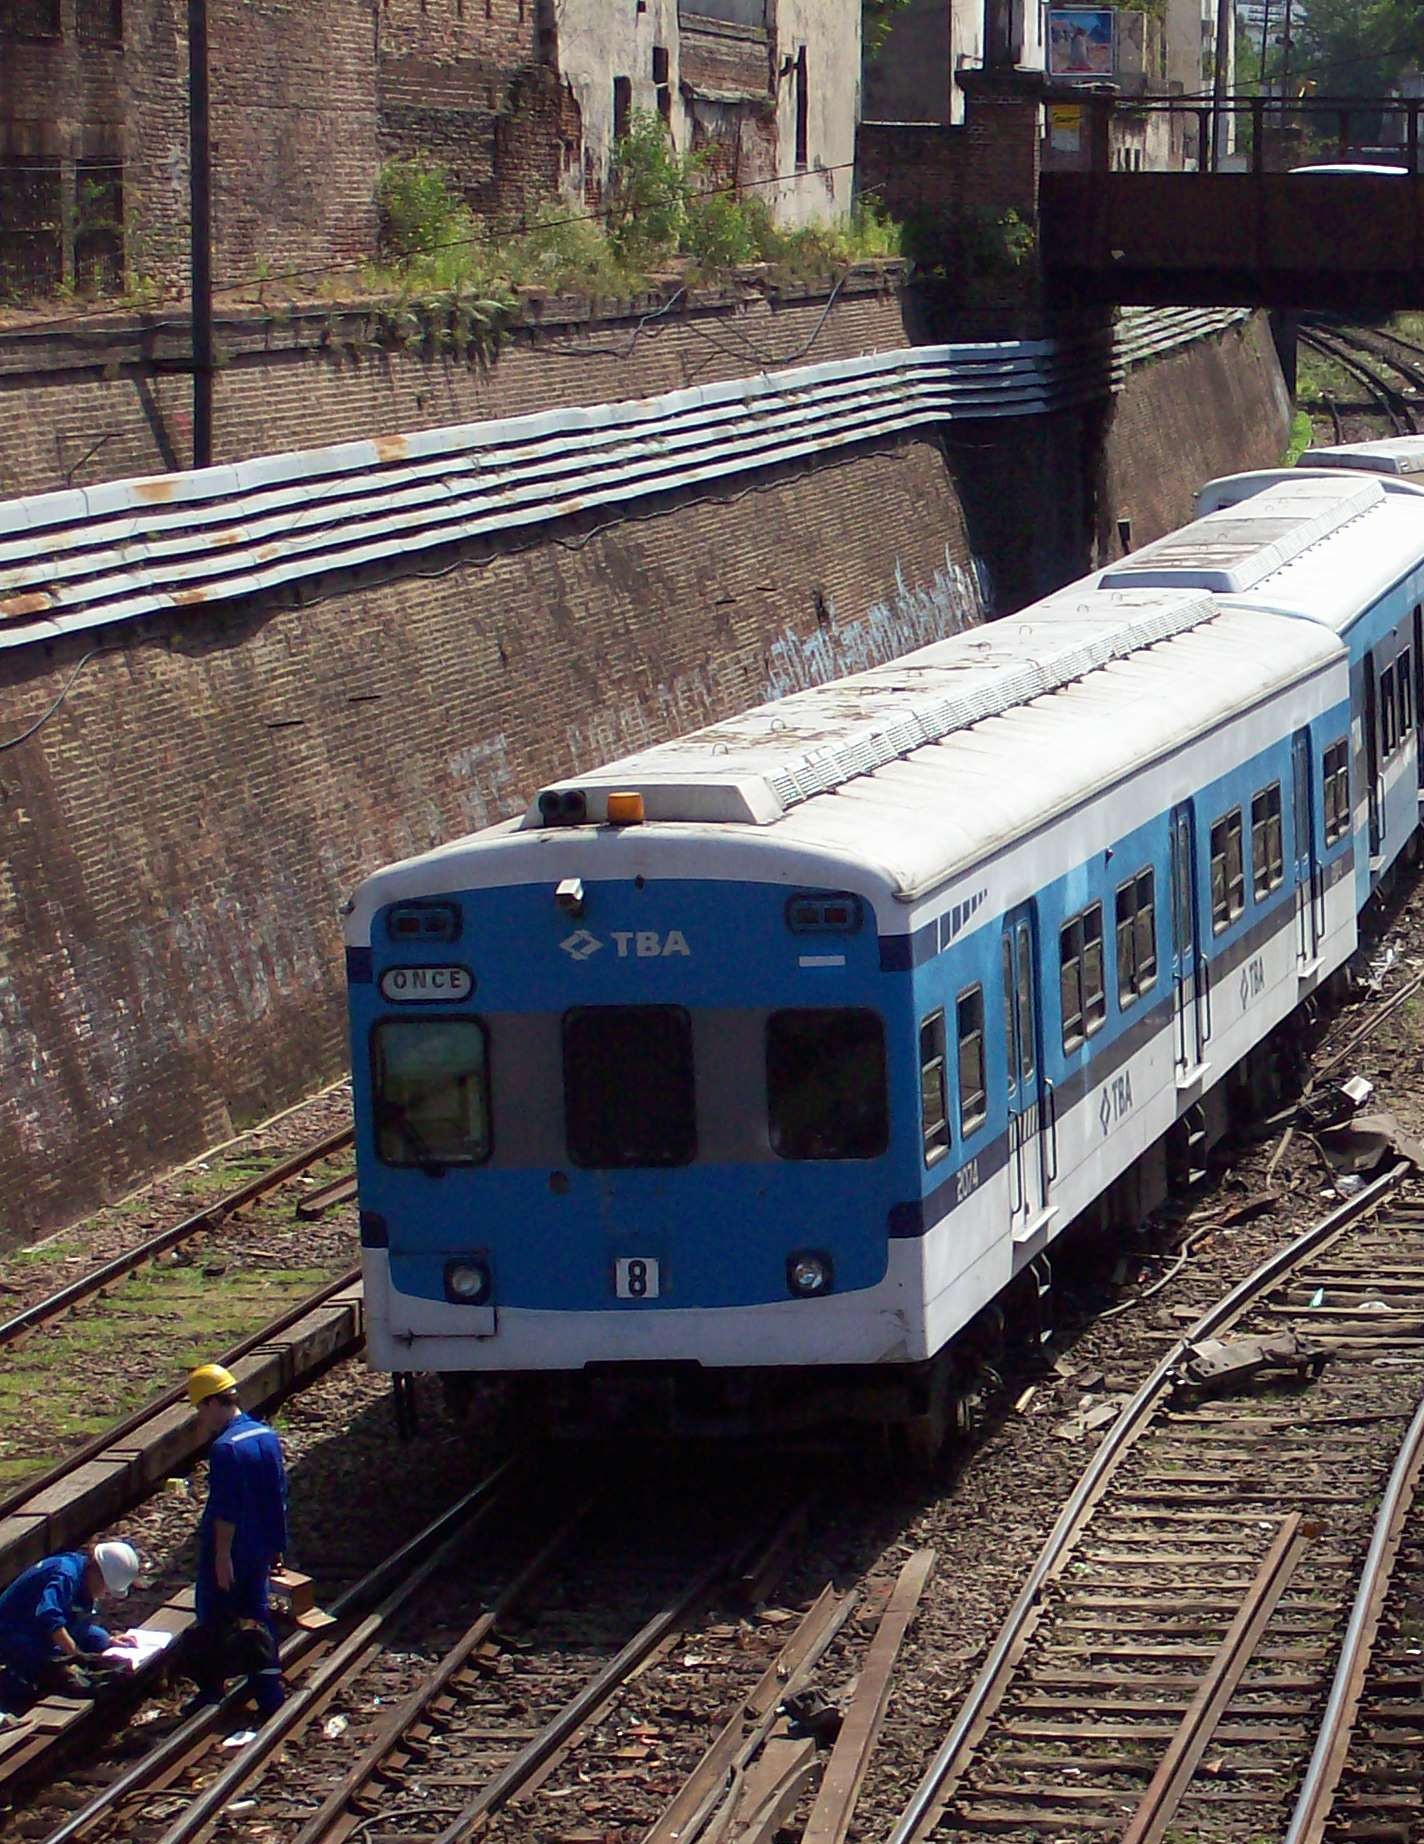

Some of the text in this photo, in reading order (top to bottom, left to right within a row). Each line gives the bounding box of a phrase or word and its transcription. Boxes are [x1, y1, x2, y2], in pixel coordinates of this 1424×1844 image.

[609, 930, 690, 957] TBA
[392, 969, 462, 989] ONCE
[1249, 955, 1265, 998] TBA
[1111, 1069, 1133, 1122] TBA
[628, 1259, 647, 1298] 8
